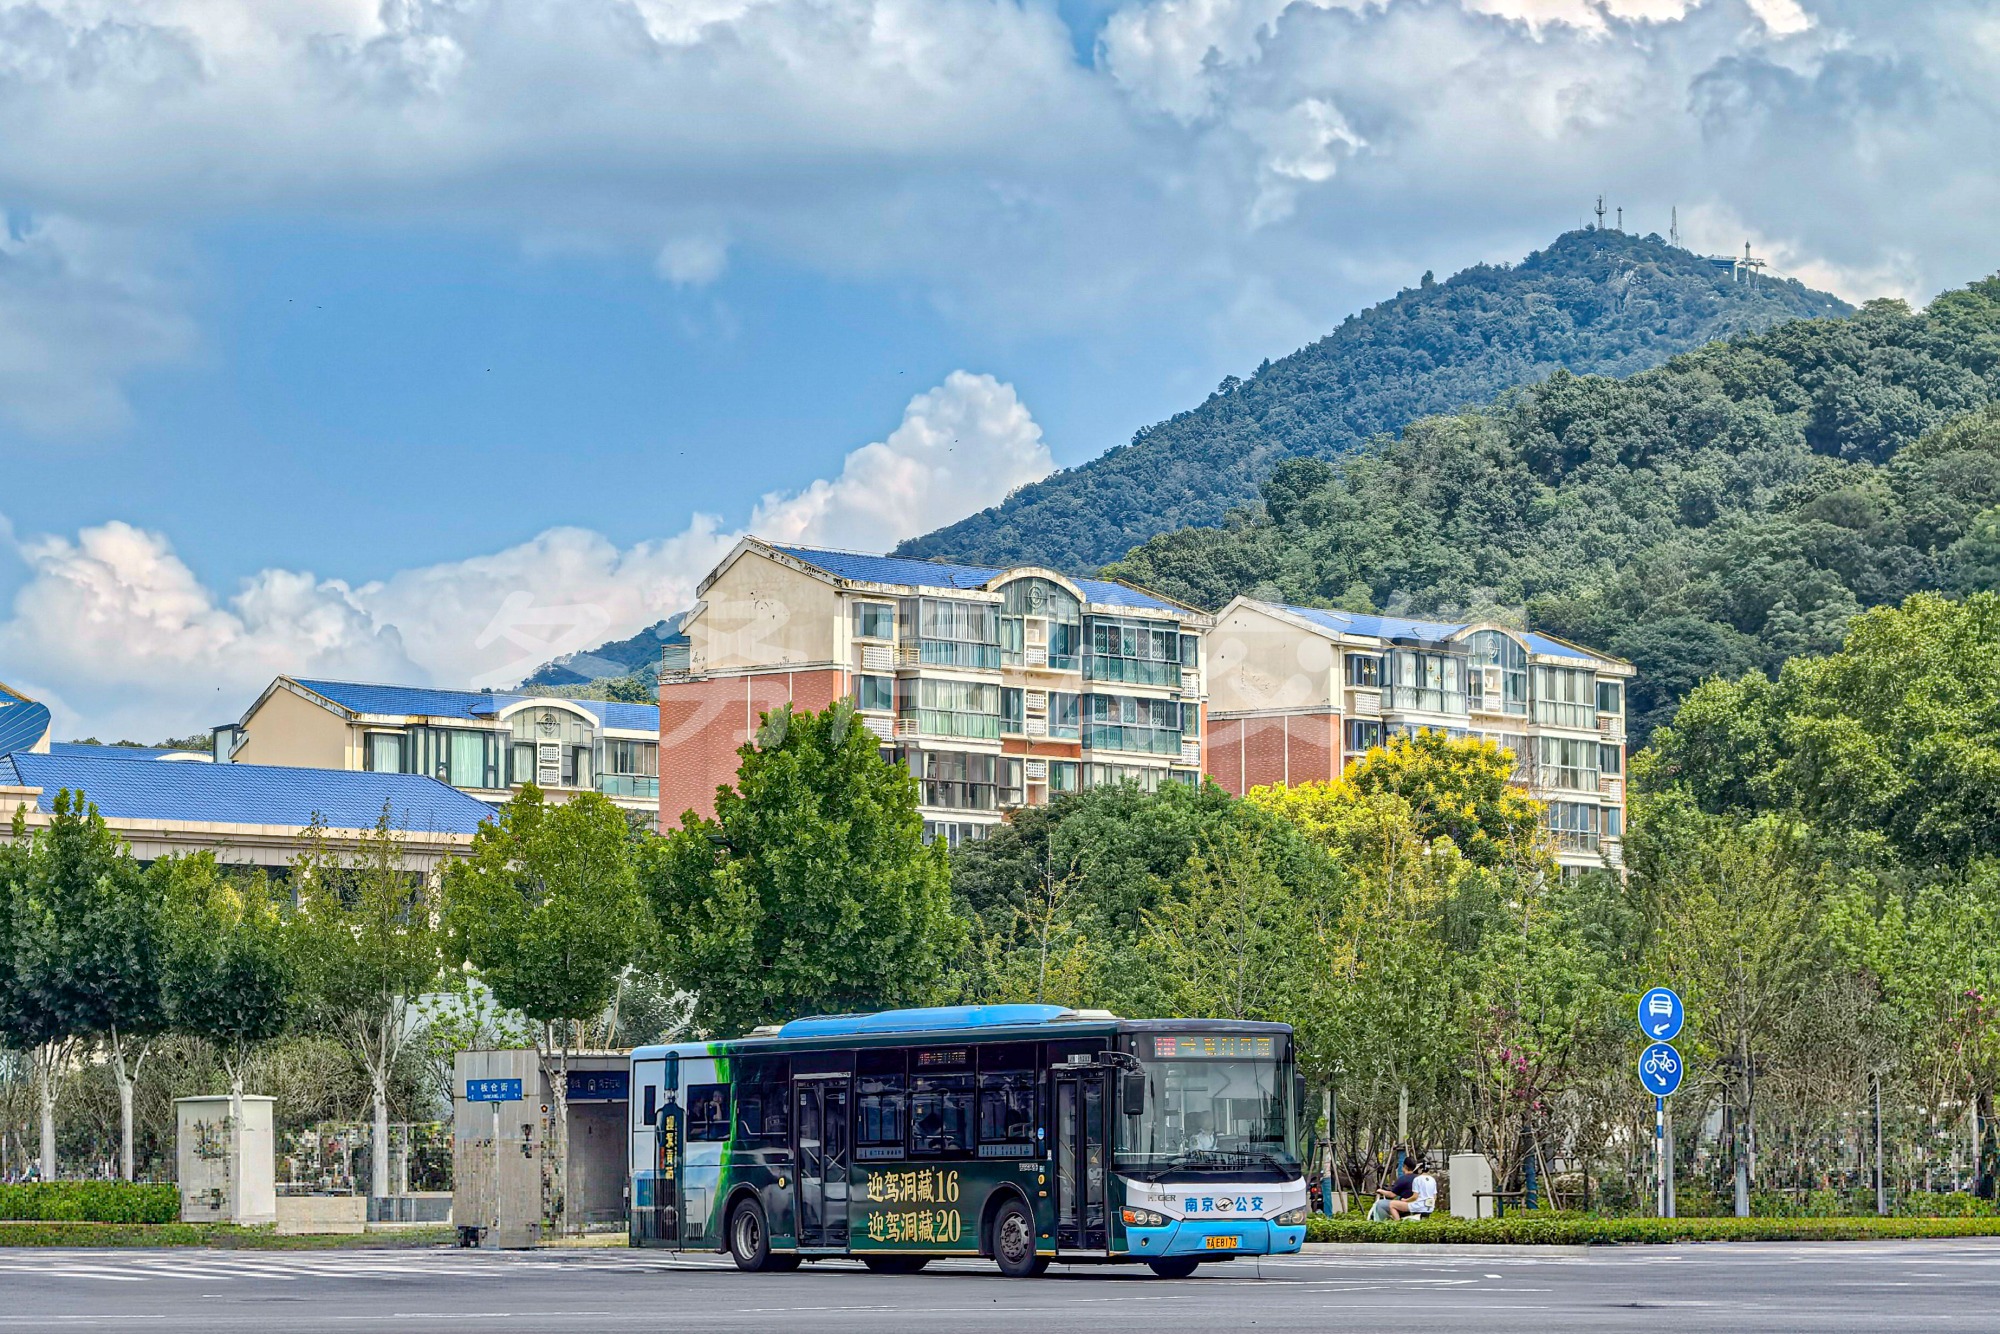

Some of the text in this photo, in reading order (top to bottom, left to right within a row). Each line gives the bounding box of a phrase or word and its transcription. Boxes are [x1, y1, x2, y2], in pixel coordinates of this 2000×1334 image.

[866, 1169, 960, 1203] 迎驾洞藏16
[1184, 1196, 1264, 1213] 南京 公交
[867, 1209, 962, 1244] 迎驾洞藏20
